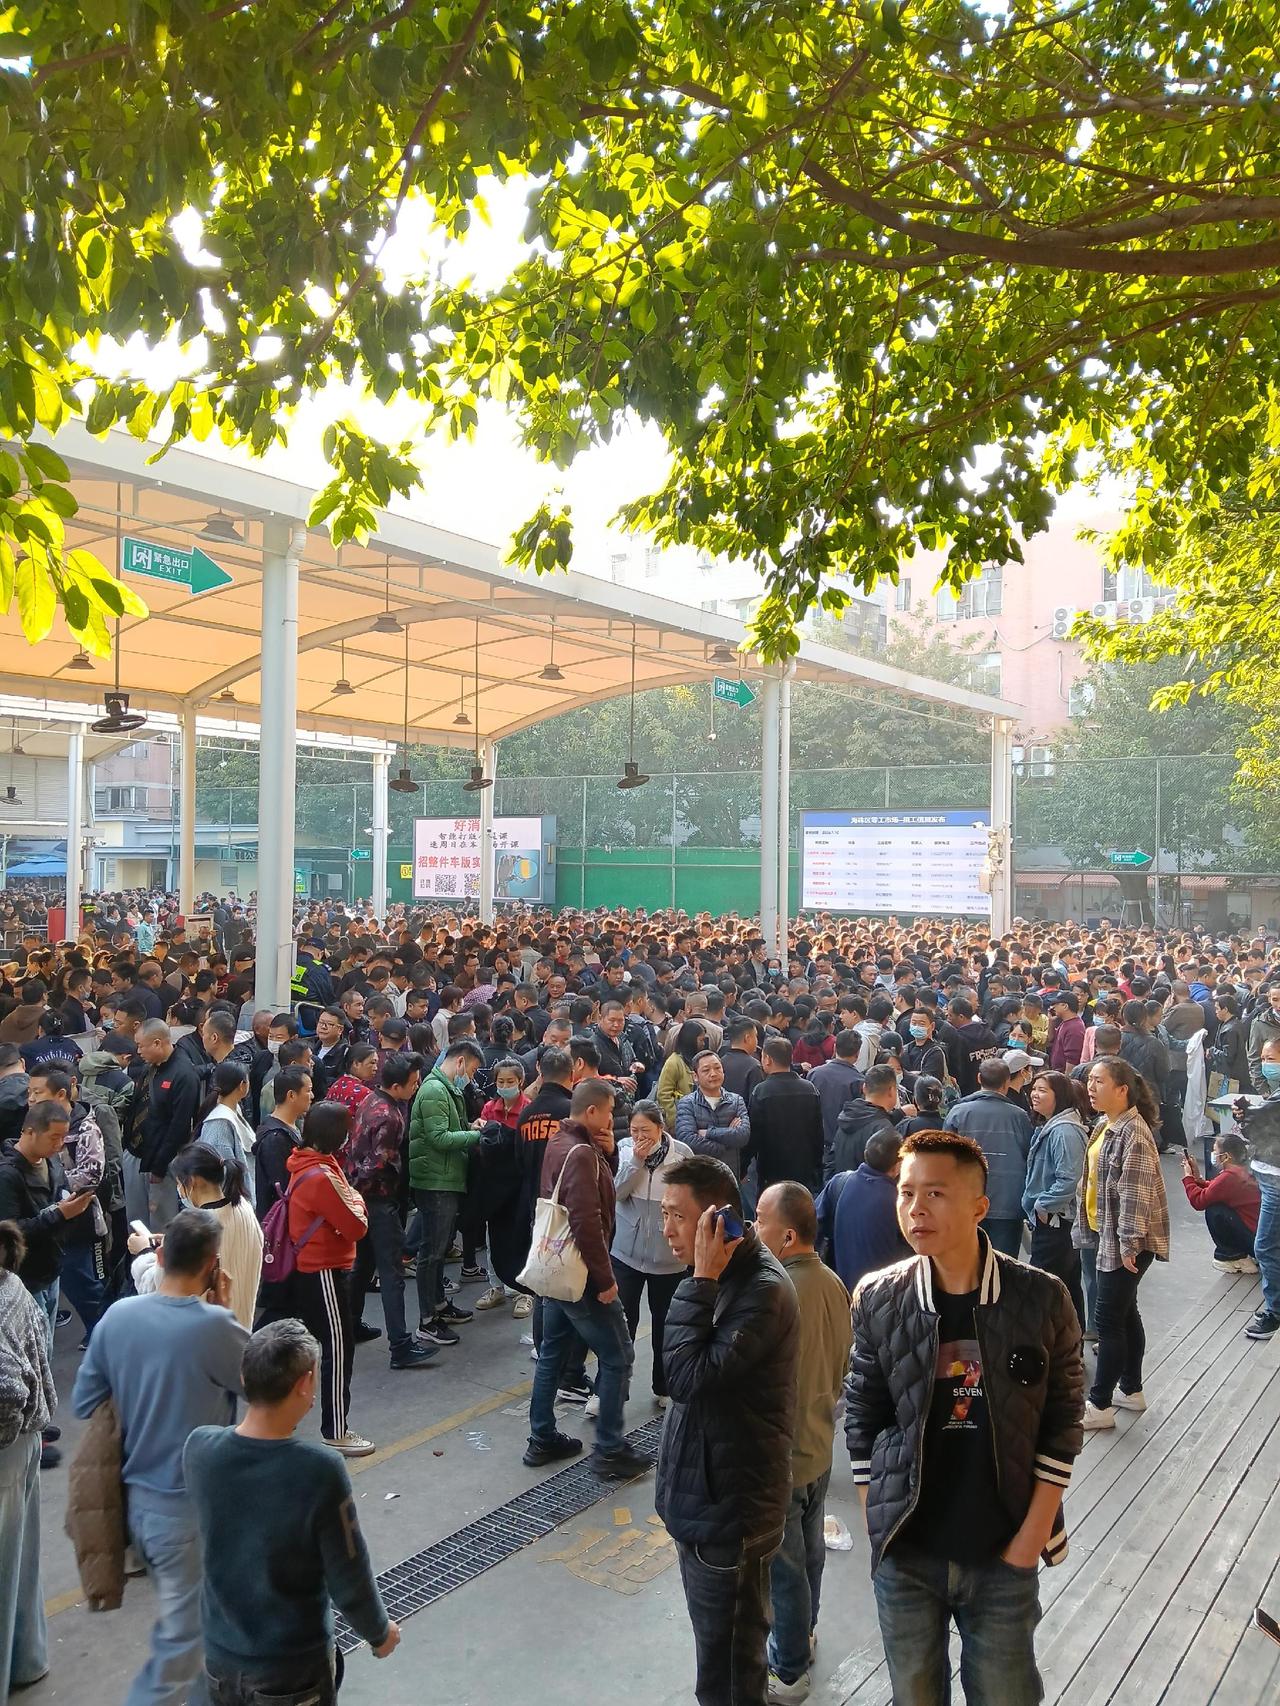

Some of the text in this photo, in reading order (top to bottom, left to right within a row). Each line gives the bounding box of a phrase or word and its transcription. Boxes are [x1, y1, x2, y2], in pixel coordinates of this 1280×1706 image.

[160, 565, 182, 575] EXIT
[454, 819, 481, 832] 好消
[418, 855, 481, 869] 招整件车版实
[94, 1241, 105, 1280] GORDON
[953, 1387, 983, 1397] SEVEN
